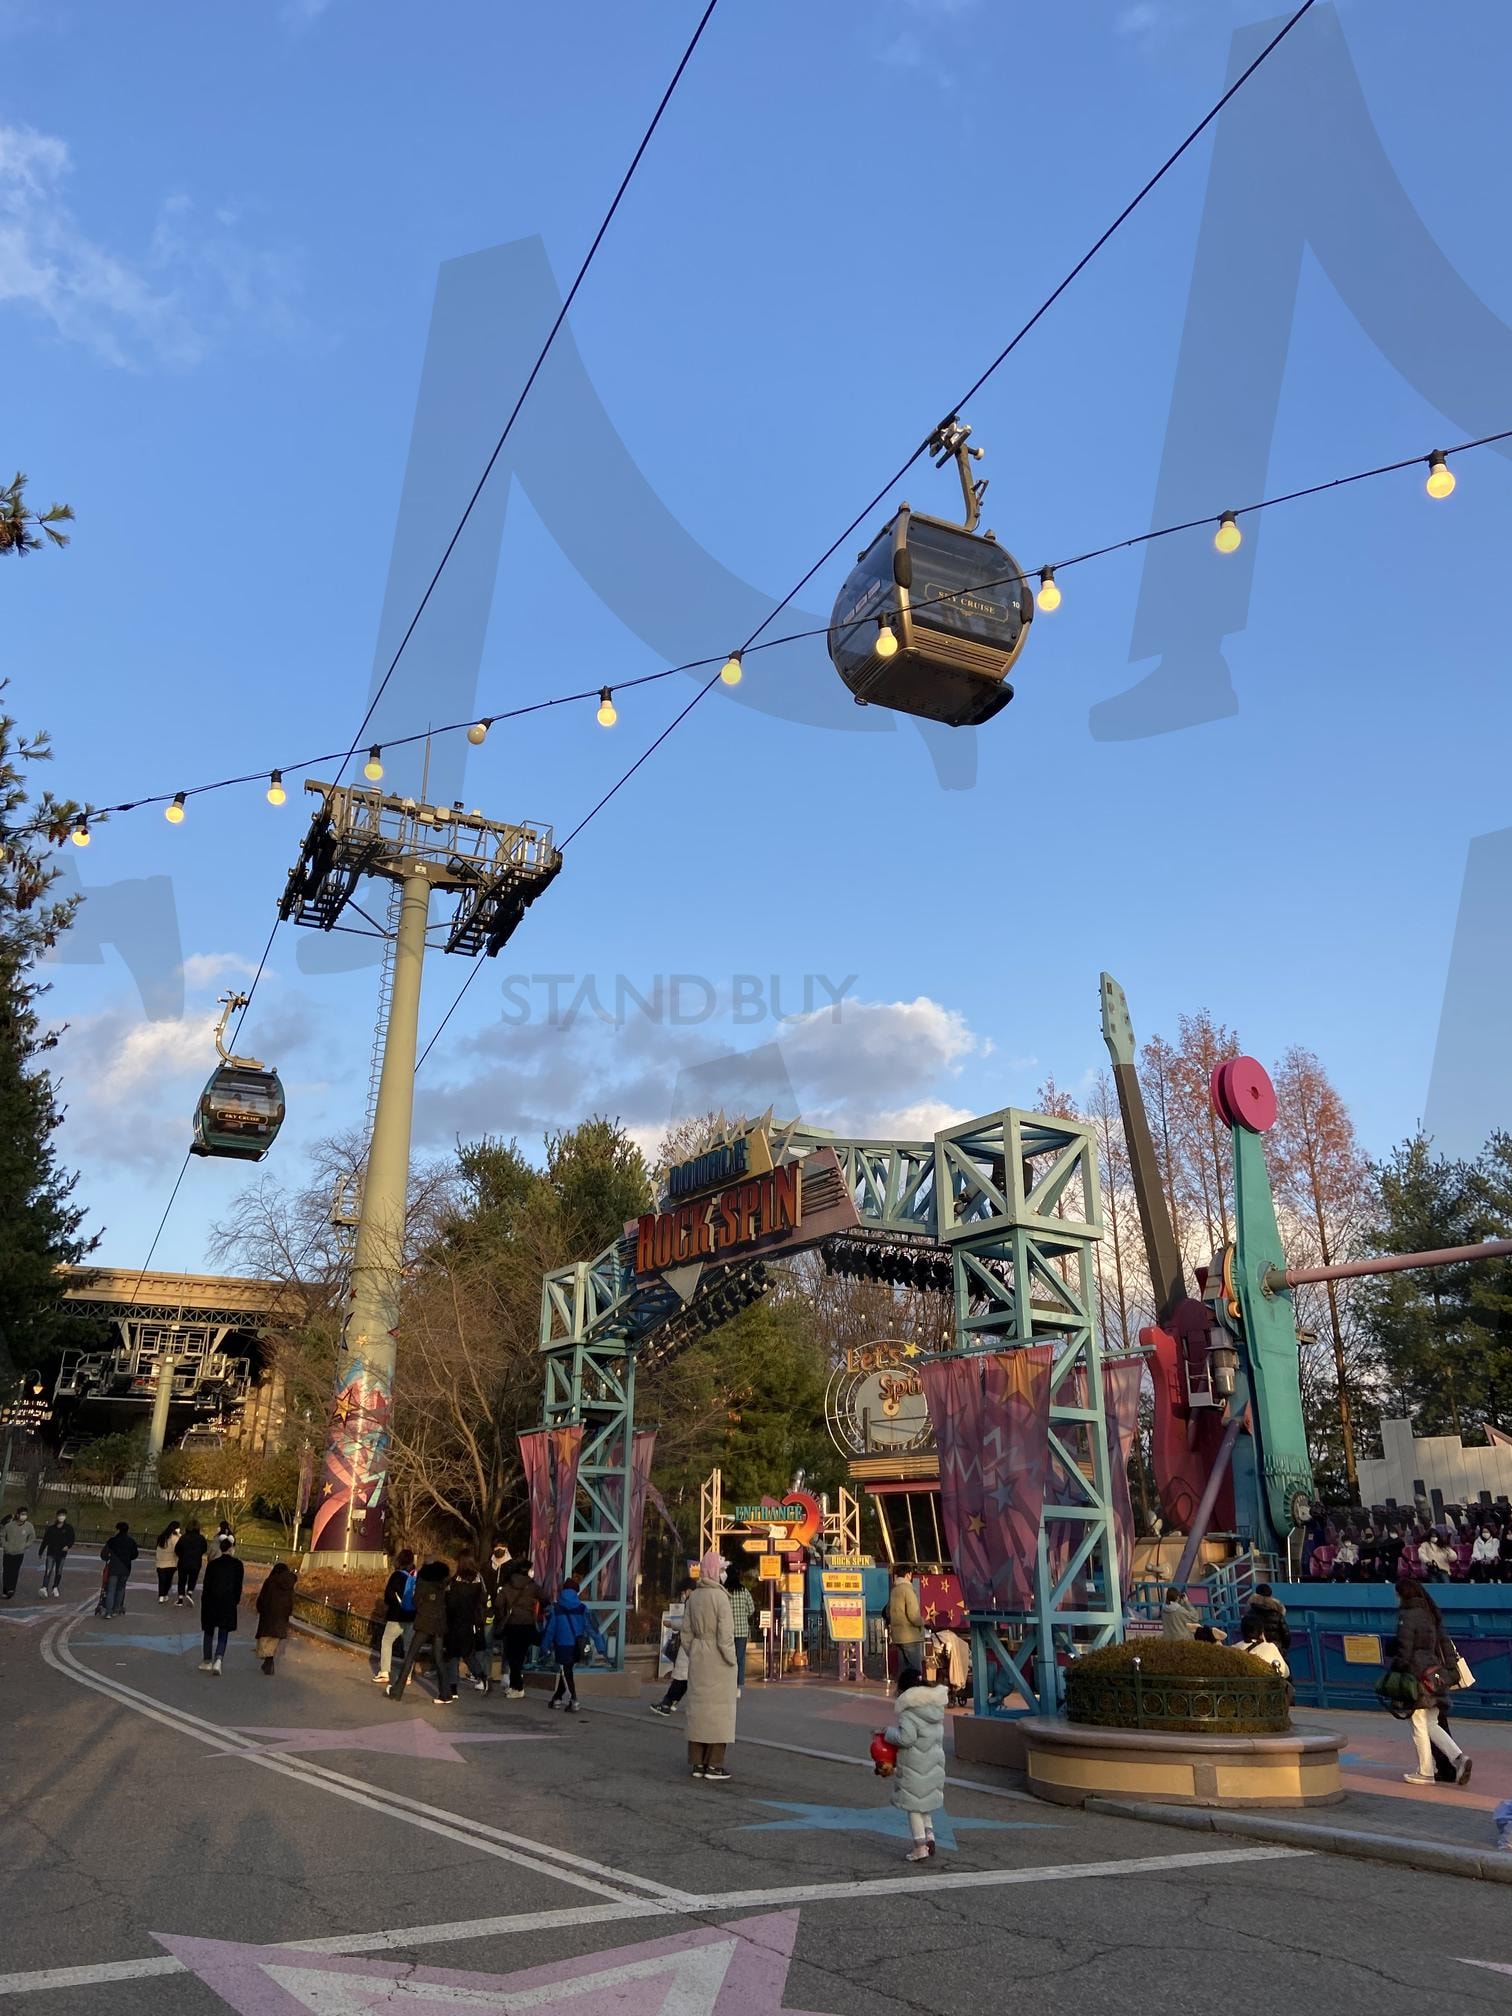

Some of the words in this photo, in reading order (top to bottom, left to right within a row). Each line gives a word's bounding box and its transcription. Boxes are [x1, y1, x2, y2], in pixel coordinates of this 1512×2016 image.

[960, 598, 995, 613] CRUISE
[636, 1200, 714, 1274] ROCK
[717, 1160, 802, 1249] SPIN
[846, 1342, 901, 1373] Let's
[735, 1505, 803, 1520] ENTRANCE
[831, 1556, 850, 1566] ROCK
[852, 1556, 870, 1566] SPIN
